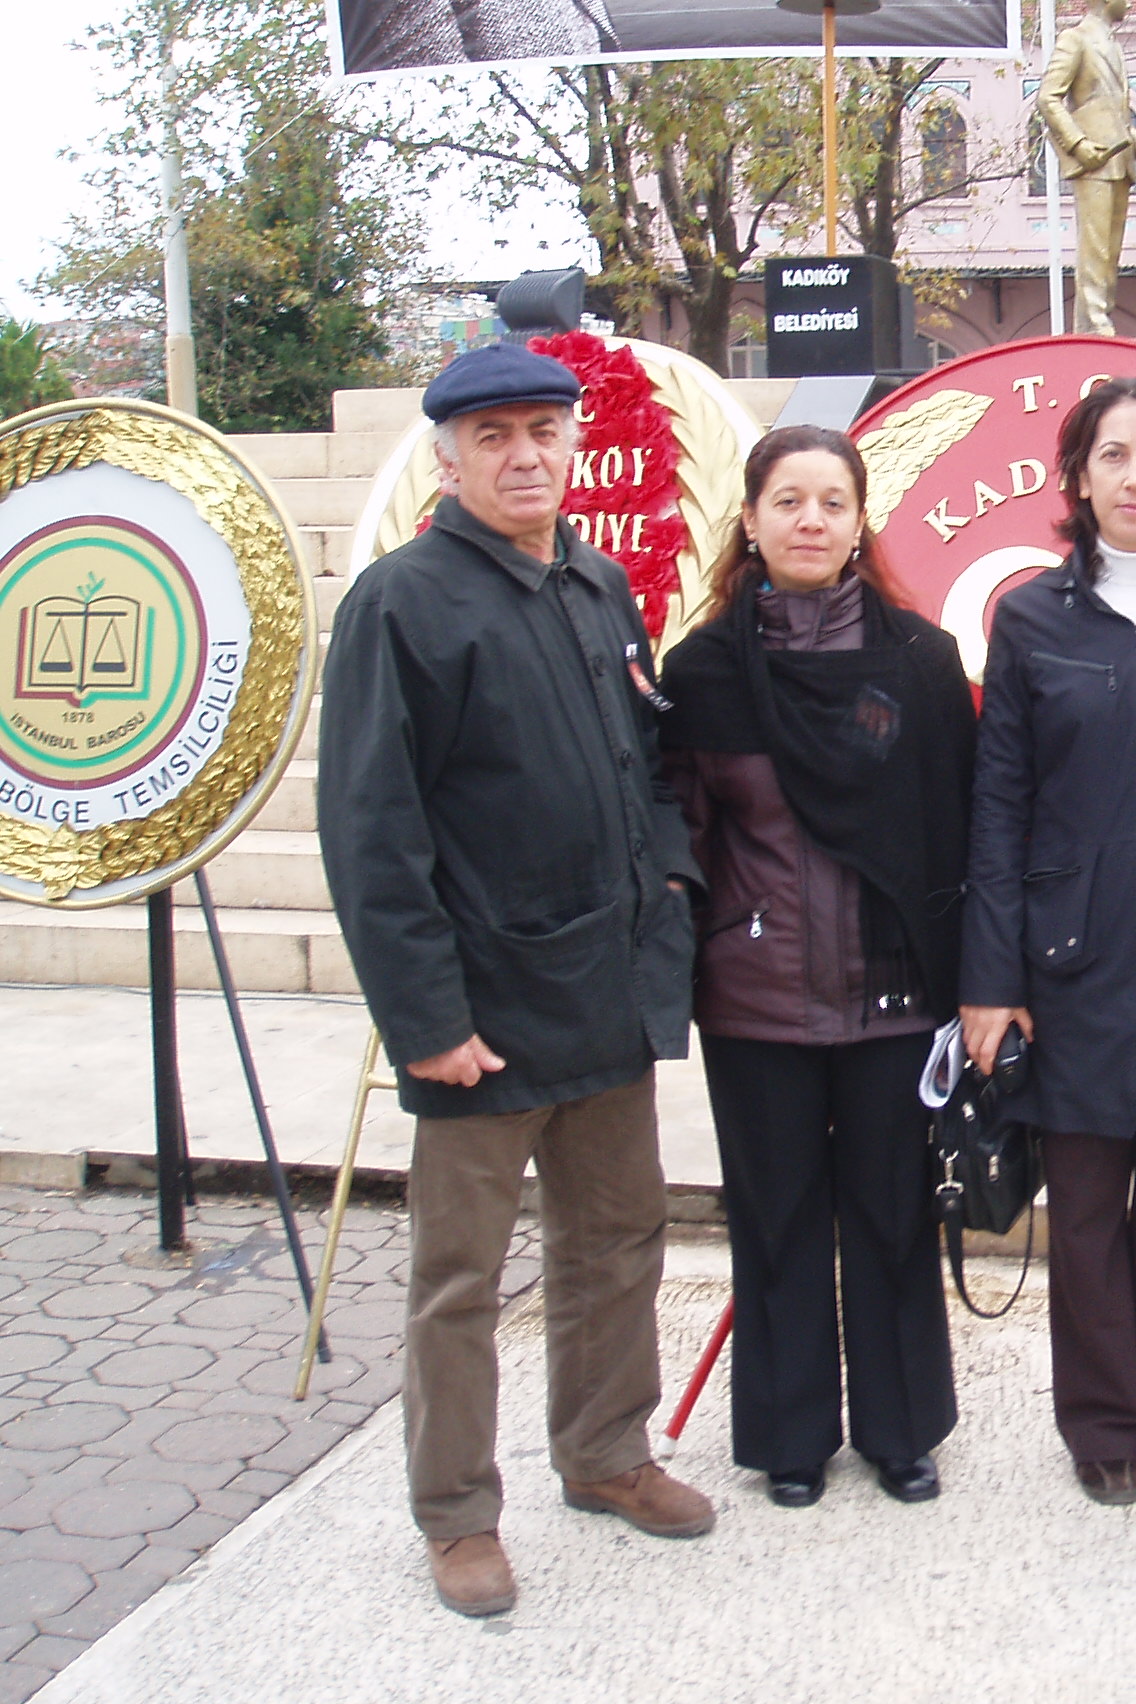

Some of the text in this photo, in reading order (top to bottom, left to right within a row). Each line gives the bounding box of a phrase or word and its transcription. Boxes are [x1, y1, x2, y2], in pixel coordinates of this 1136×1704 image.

[782, 264, 850, 287] KADIKÖY
[774, 307, 858, 333] BELEDİYESİ
[922, 457, 1067, 543] KAD
[0, 640, 239, 823] BÖLGE TEMSİLCİLİĞİ
[62, 711, 95, 724] 1878
[87, 711, 146, 749] BAROSU
